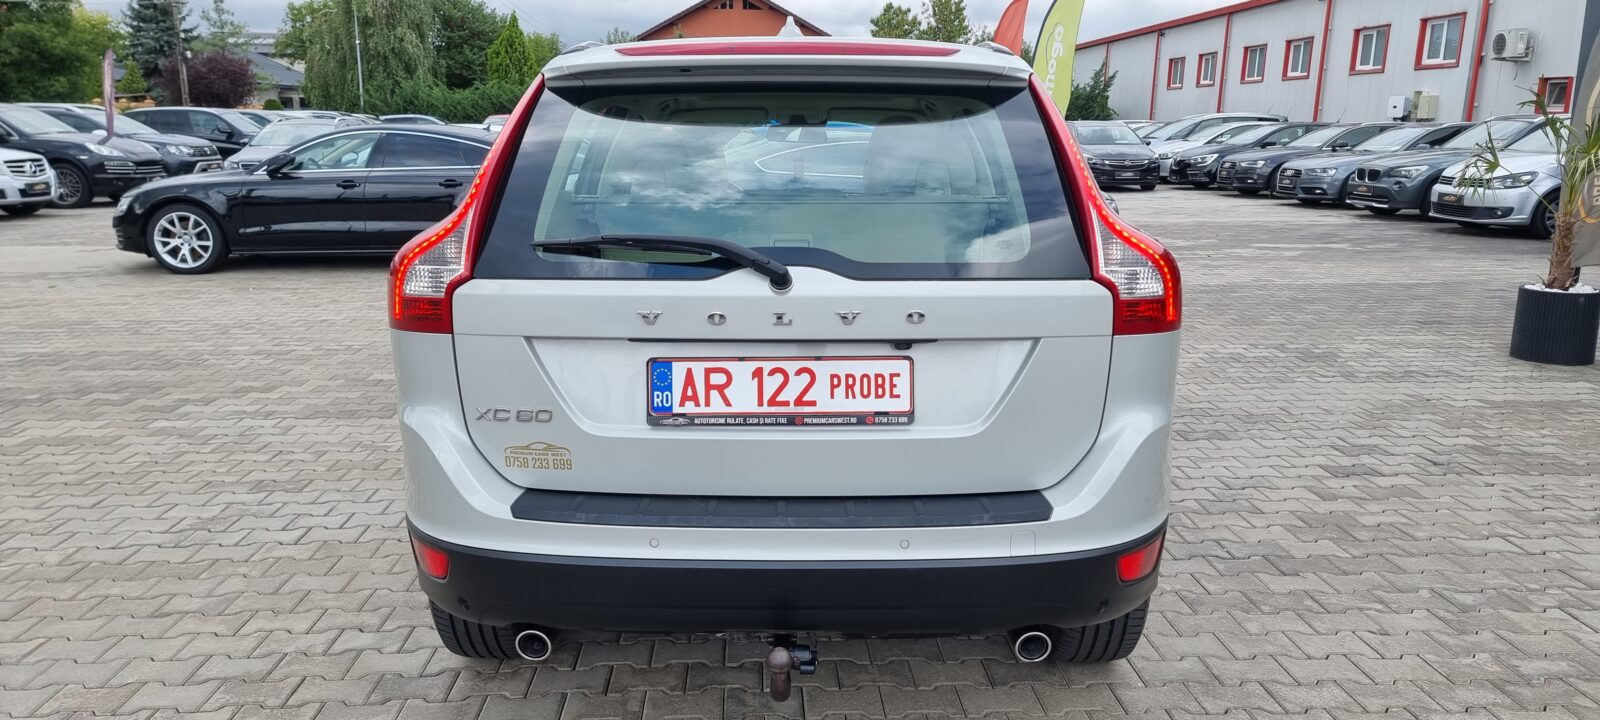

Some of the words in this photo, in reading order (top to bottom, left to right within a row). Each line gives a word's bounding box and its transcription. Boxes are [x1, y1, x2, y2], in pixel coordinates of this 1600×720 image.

[636, 310, 927, 327] VOLVO
[653, 391, 672, 408] RO
[678, 367, 733, 407] AR
[752, 366, 817, 407] 122
[829, 372, 901, 399] PROBE
[803, 416, 857, 424] PREMIUMCARSWEST.RO
[505, 456, 529, 468] 0758
[531, 457, 550, 469] 233
[552, 458, 573, 470] 699
